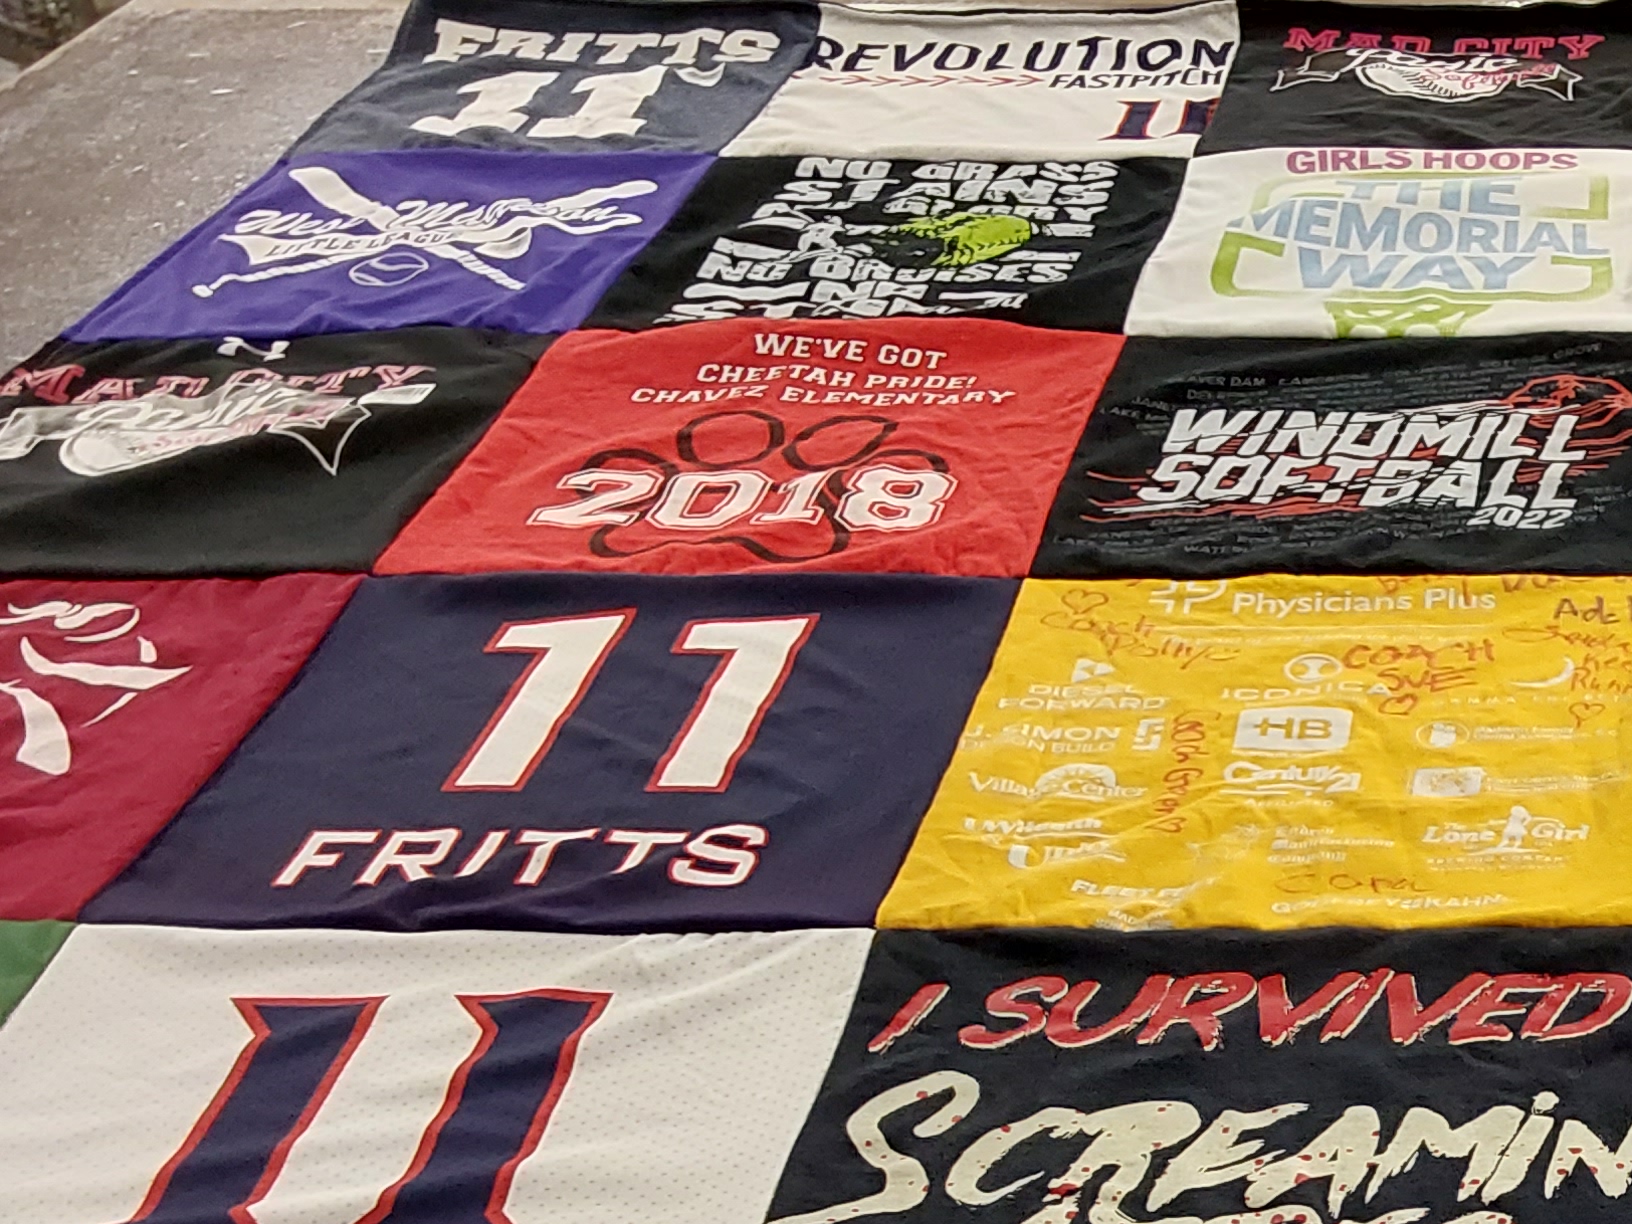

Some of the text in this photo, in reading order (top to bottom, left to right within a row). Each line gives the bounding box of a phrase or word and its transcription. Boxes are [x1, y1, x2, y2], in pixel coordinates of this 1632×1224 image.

[422, 18, 781, 65] FRITTS
[803, 36, 1235, 72] REVOLUTION
[1283, 28, 1605, 60] MAD CITY
[1049, 68, 1223, 90] FASTPITCH
[409, 65, 669, 137] 11
[911, 161, 1120, 182] GRASS
[1286, 150, 1579, 174] GIRLS HOOPS
[774, 178, 1116, 204] STAINS
[1335, 176, 1523, 216] THE
[1226, 200, 1611, 255] MEMORIAL
[1297, 247, 1537, 290] WAY
[754, 334, 948, 370] WE'VE GOT
[696, 363, 978, 391] CHEETAH PRIDE!
[630, 384, 1016, 407] CHAVEZ ELEMENTARY
[1161, 408, 1588, 462] WINDMILL
[526, 464, 958, 531] 2018
[1136, 454, 1578, 509] SOFTBALL
[1466, 505, 1573, 530] 2022
[1231, 587, 1497, 620] Physicians Plus
[441, 607, 821, 793] 11
[997, 696, 1168, 712] FORWARD
[1027, 683, 1147, 698] DIESEL
[1221, 680, 1393, 700] ICONICA
[1253, 716, 1333, 740] HB
[968, 771, 1149, 800] Village Center
[1223, 760, 1362, 794] Century 21
[1421, 822, 1591, 843] Lone Girl
[271, 824, 770, 888] FRITTS
[867, 982, 951, 1054] I
